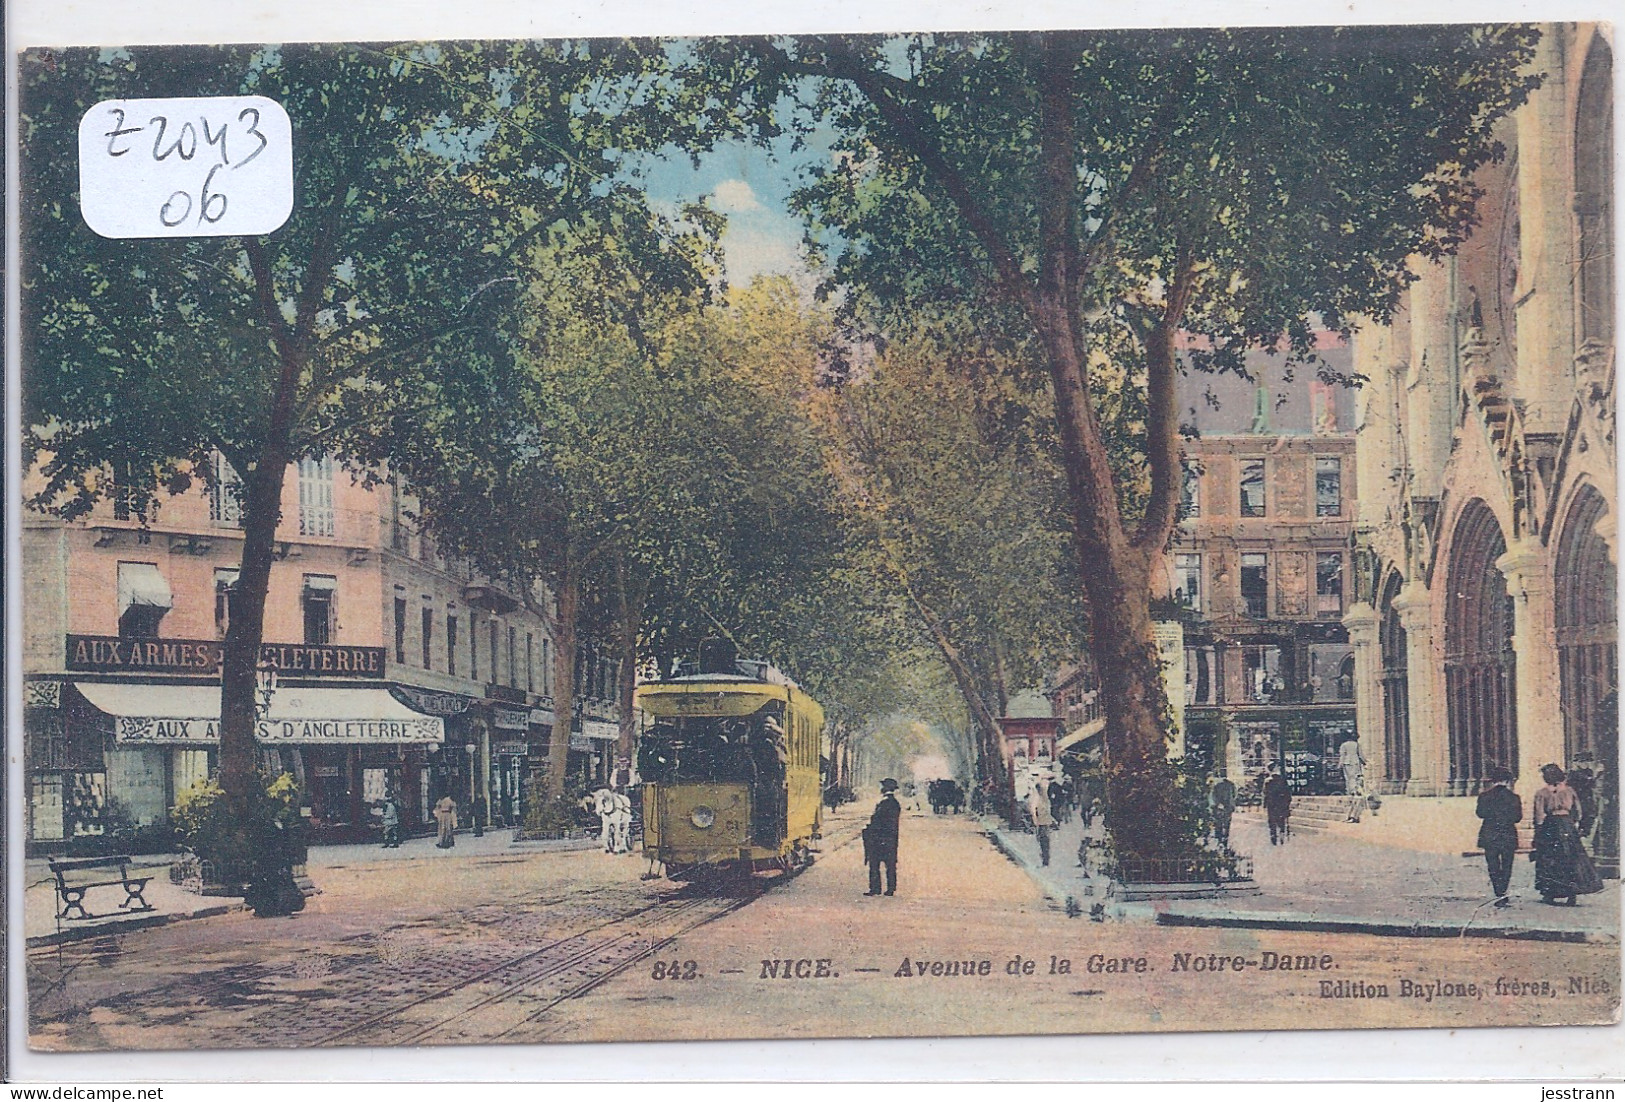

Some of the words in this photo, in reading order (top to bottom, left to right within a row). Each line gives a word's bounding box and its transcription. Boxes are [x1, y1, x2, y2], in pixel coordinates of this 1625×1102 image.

[159, 163, 228, 228] 06
[74, 640, 123, 664] AUX
[129, 642, 209, 667] ARMES
[156, 721, 190, 738] AUX
[283, 721, 412, 739] D'ANGLETERRE
